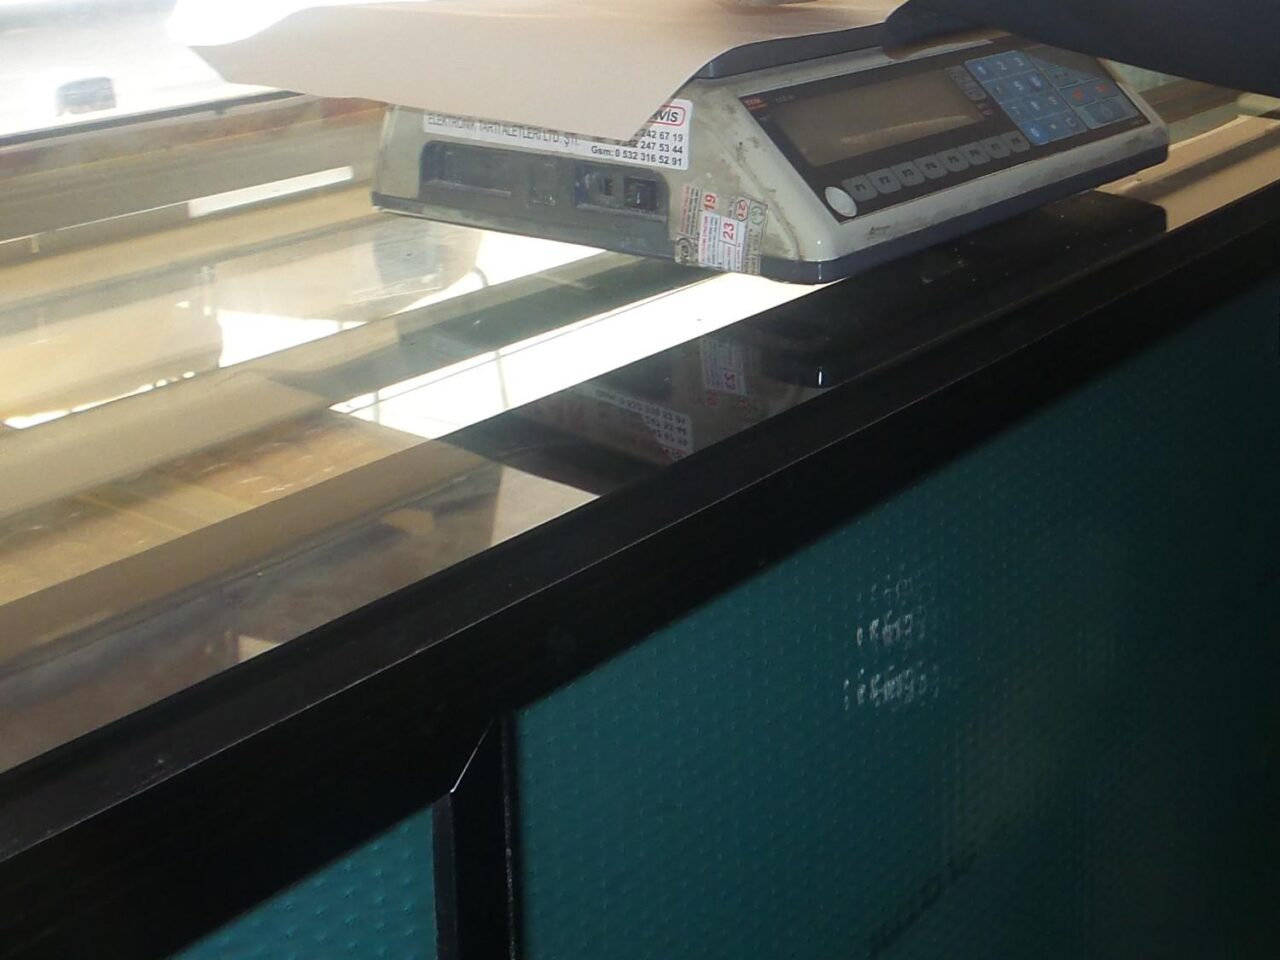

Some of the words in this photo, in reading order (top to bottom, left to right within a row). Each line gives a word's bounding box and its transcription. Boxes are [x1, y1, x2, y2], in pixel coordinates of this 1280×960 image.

[659, 131, 670, 140] 67
[672, 133, 684, 143] 19
[640, 140, 657, 151] 247
[659, 143, 670, 153] 53
[672, 145, 683, 154] 44
[622, 150, 638, 160] 532
[640, 152, 656, 163] 316
[659, 155, 670, 165] 52
[672, 157, 683, 167] 91
[703, 193, 716, 211] 19
[722, 221, 735, 241] 23
